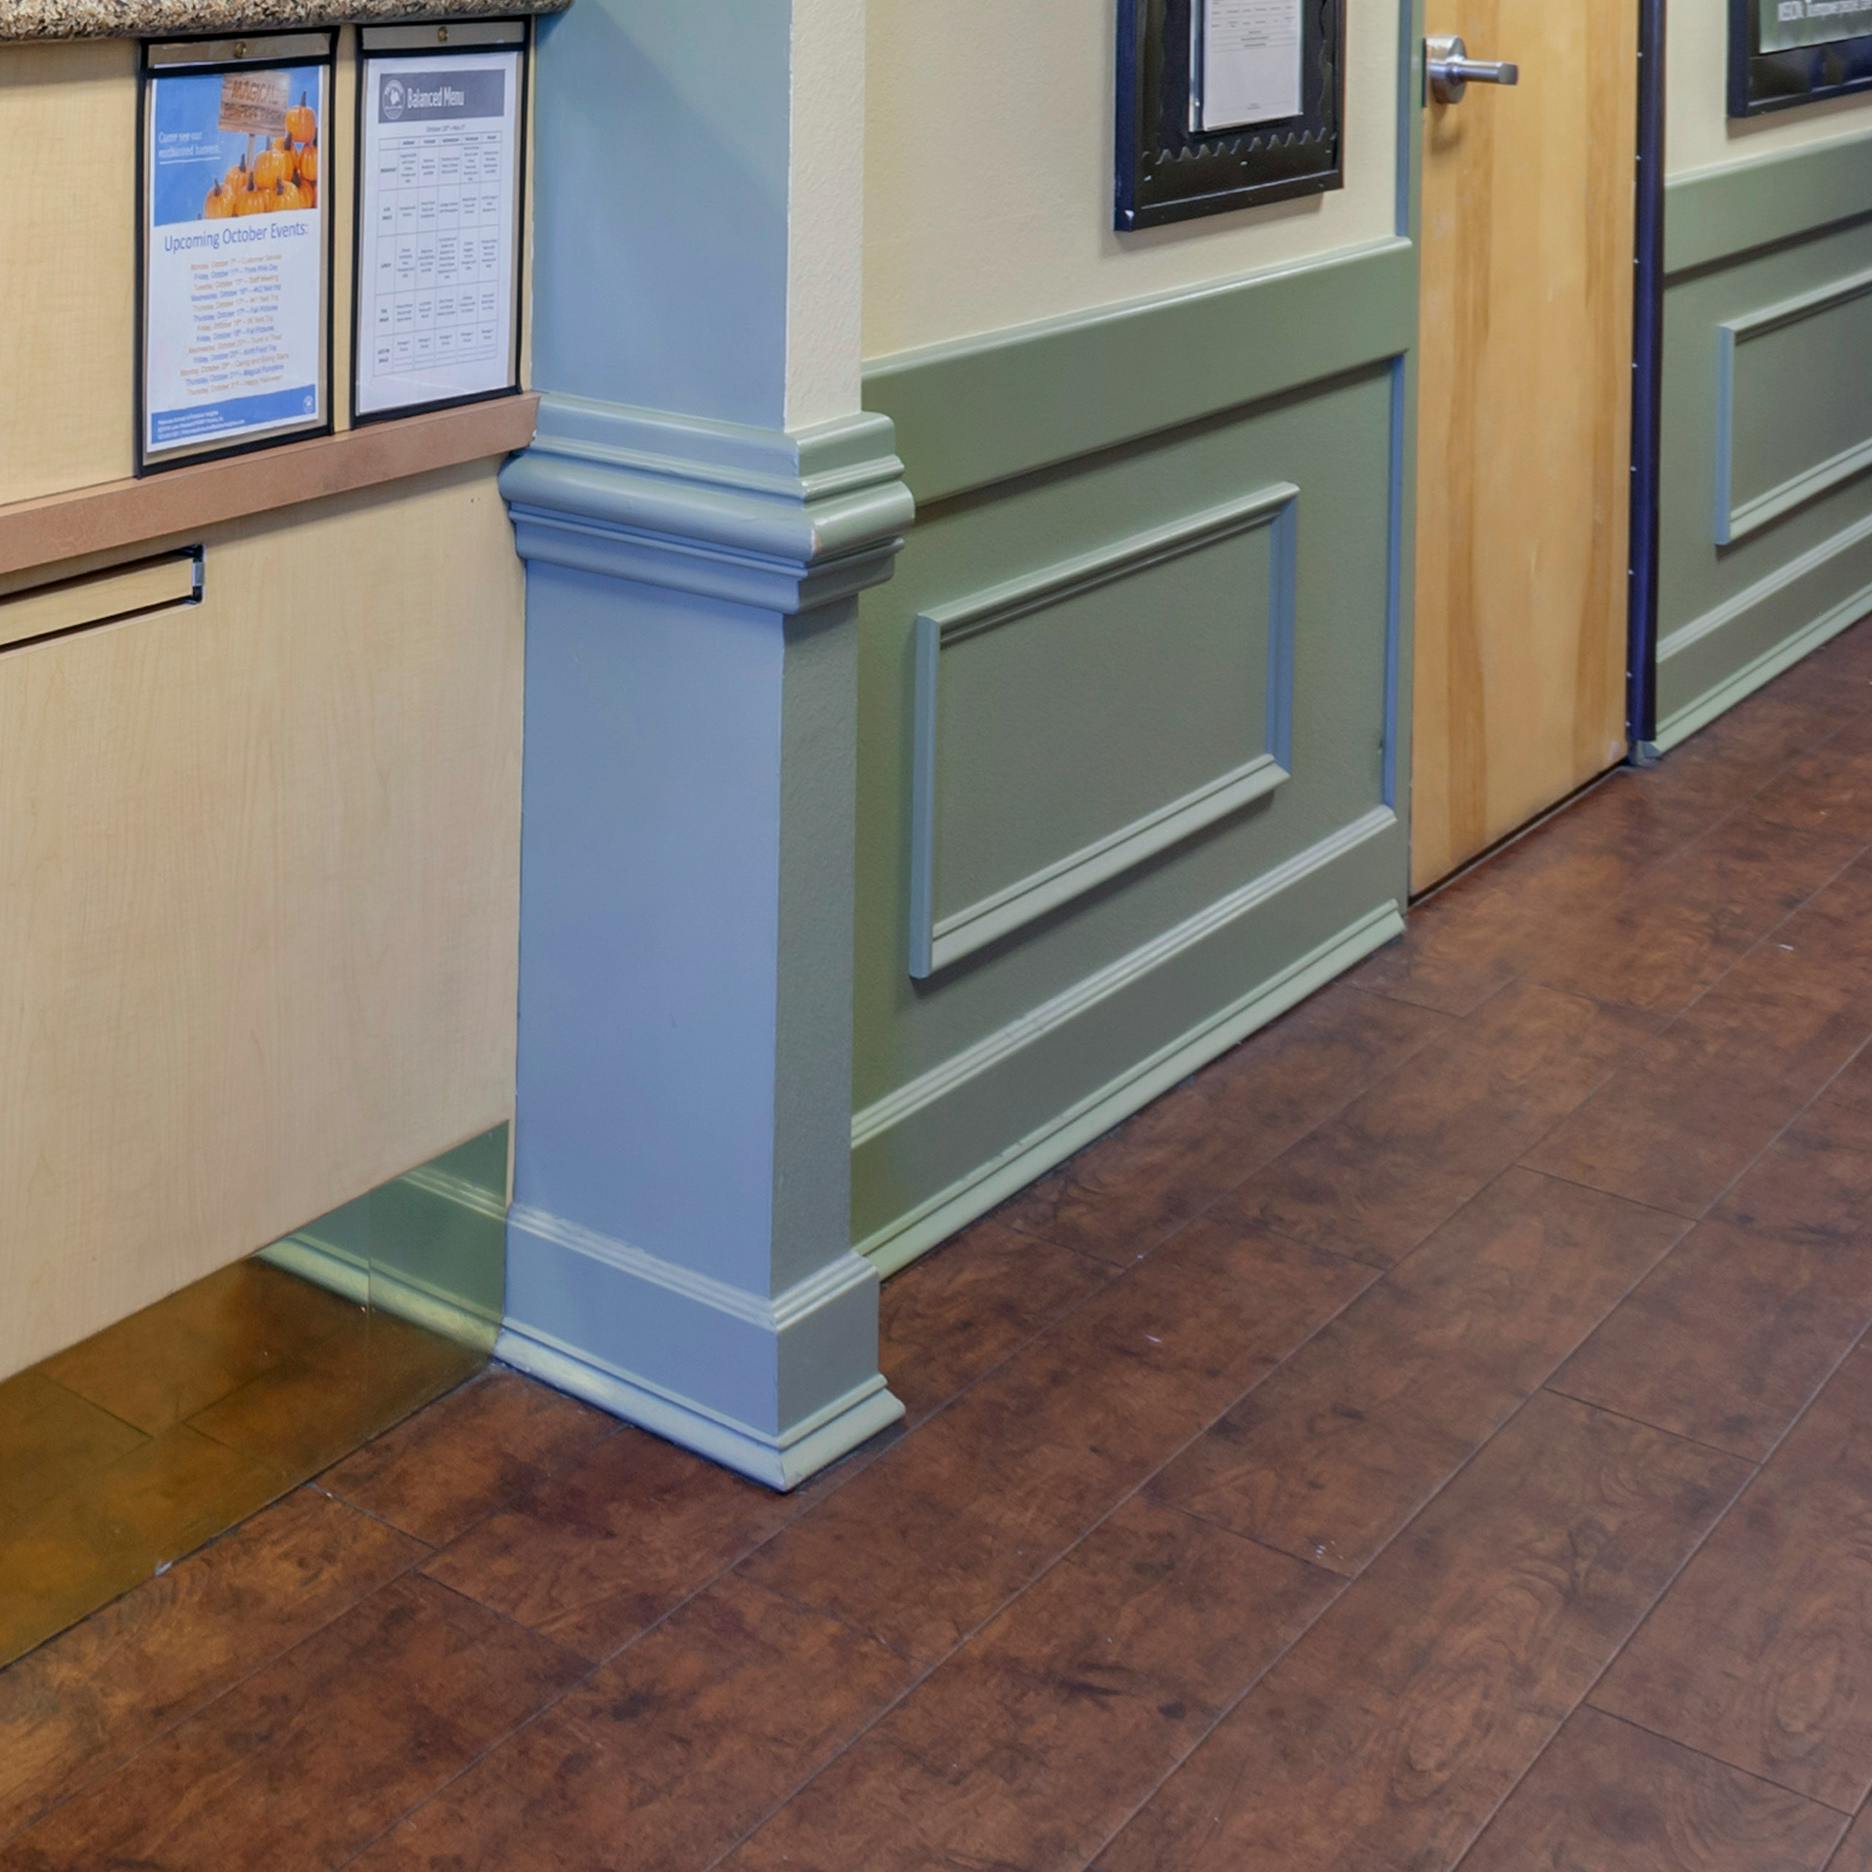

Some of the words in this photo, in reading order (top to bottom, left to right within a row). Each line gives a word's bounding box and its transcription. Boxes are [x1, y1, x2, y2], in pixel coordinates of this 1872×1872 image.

[406, 86, 443, 109] Balanced
[443, 85, 465, 108] Menu
[164, 231, 220, 254] Upcoming
[221, 225, 268, 246] October
[270, 221, 309, 241] Events:
